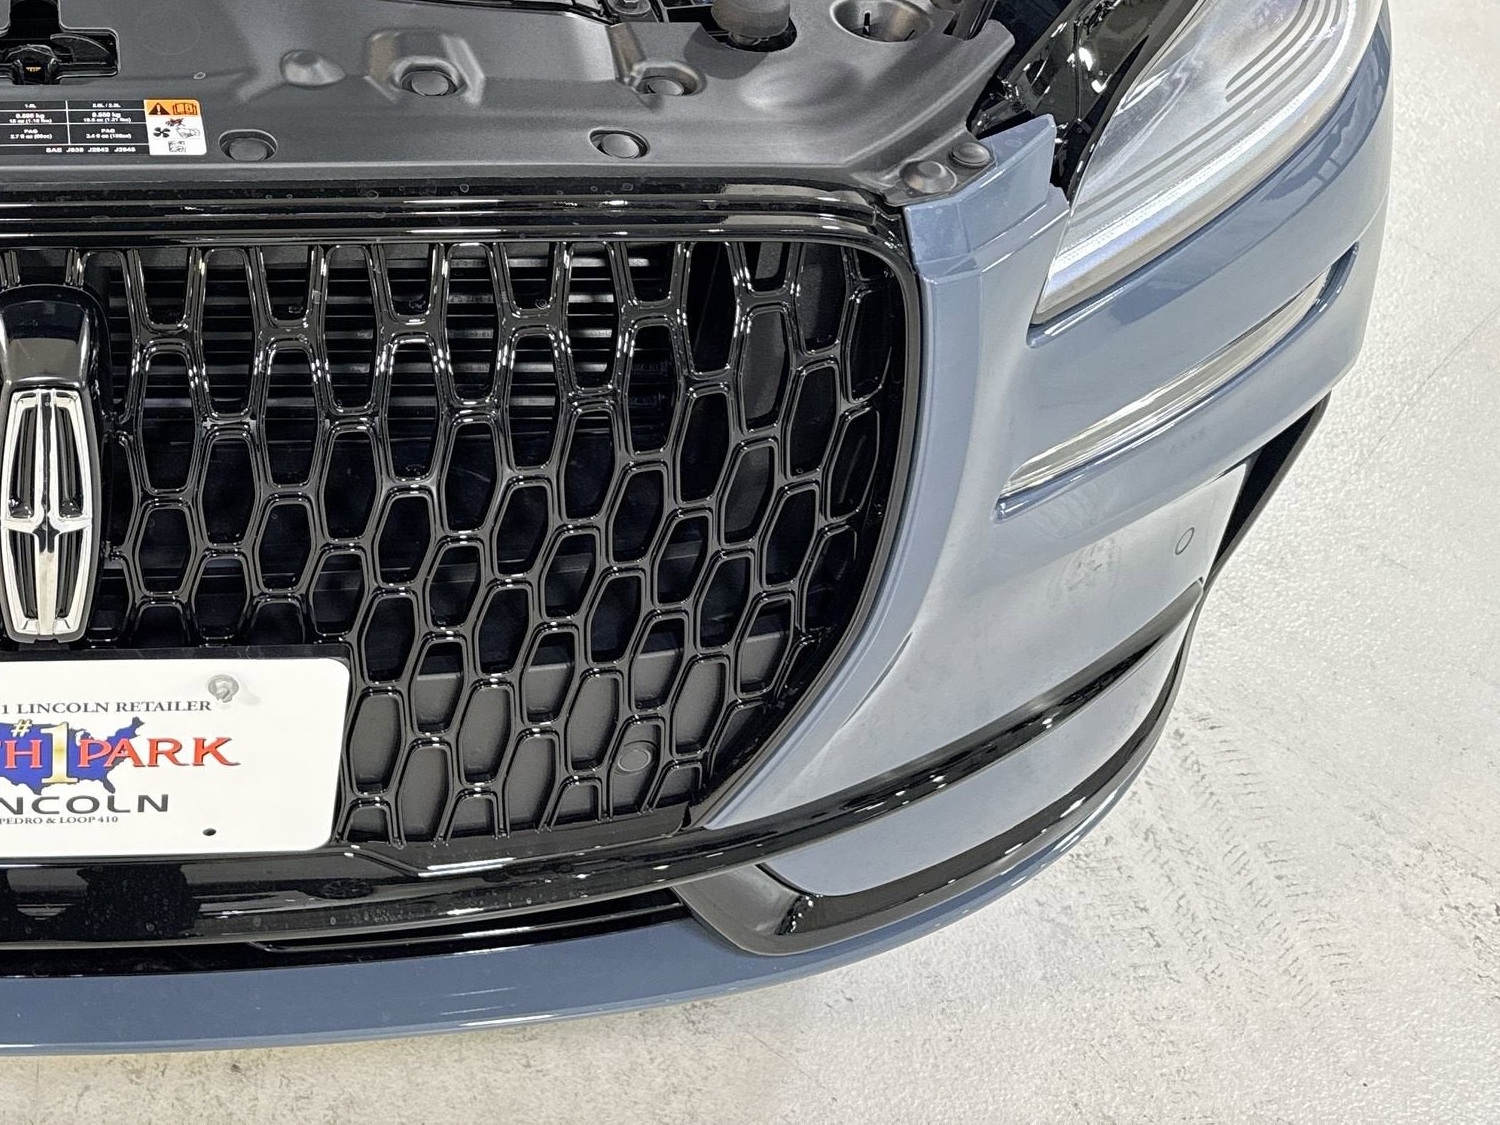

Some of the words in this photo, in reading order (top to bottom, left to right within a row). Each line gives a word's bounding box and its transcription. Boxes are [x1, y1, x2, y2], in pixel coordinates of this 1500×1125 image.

[17, 701, 110, 715] LINCOLN
[115, 700, 213, 713] RETAILER
[76, 736, 242, 768] PARK
[59, 816, 95, 824] LOOP
[97, 815, 119, 823] 410
